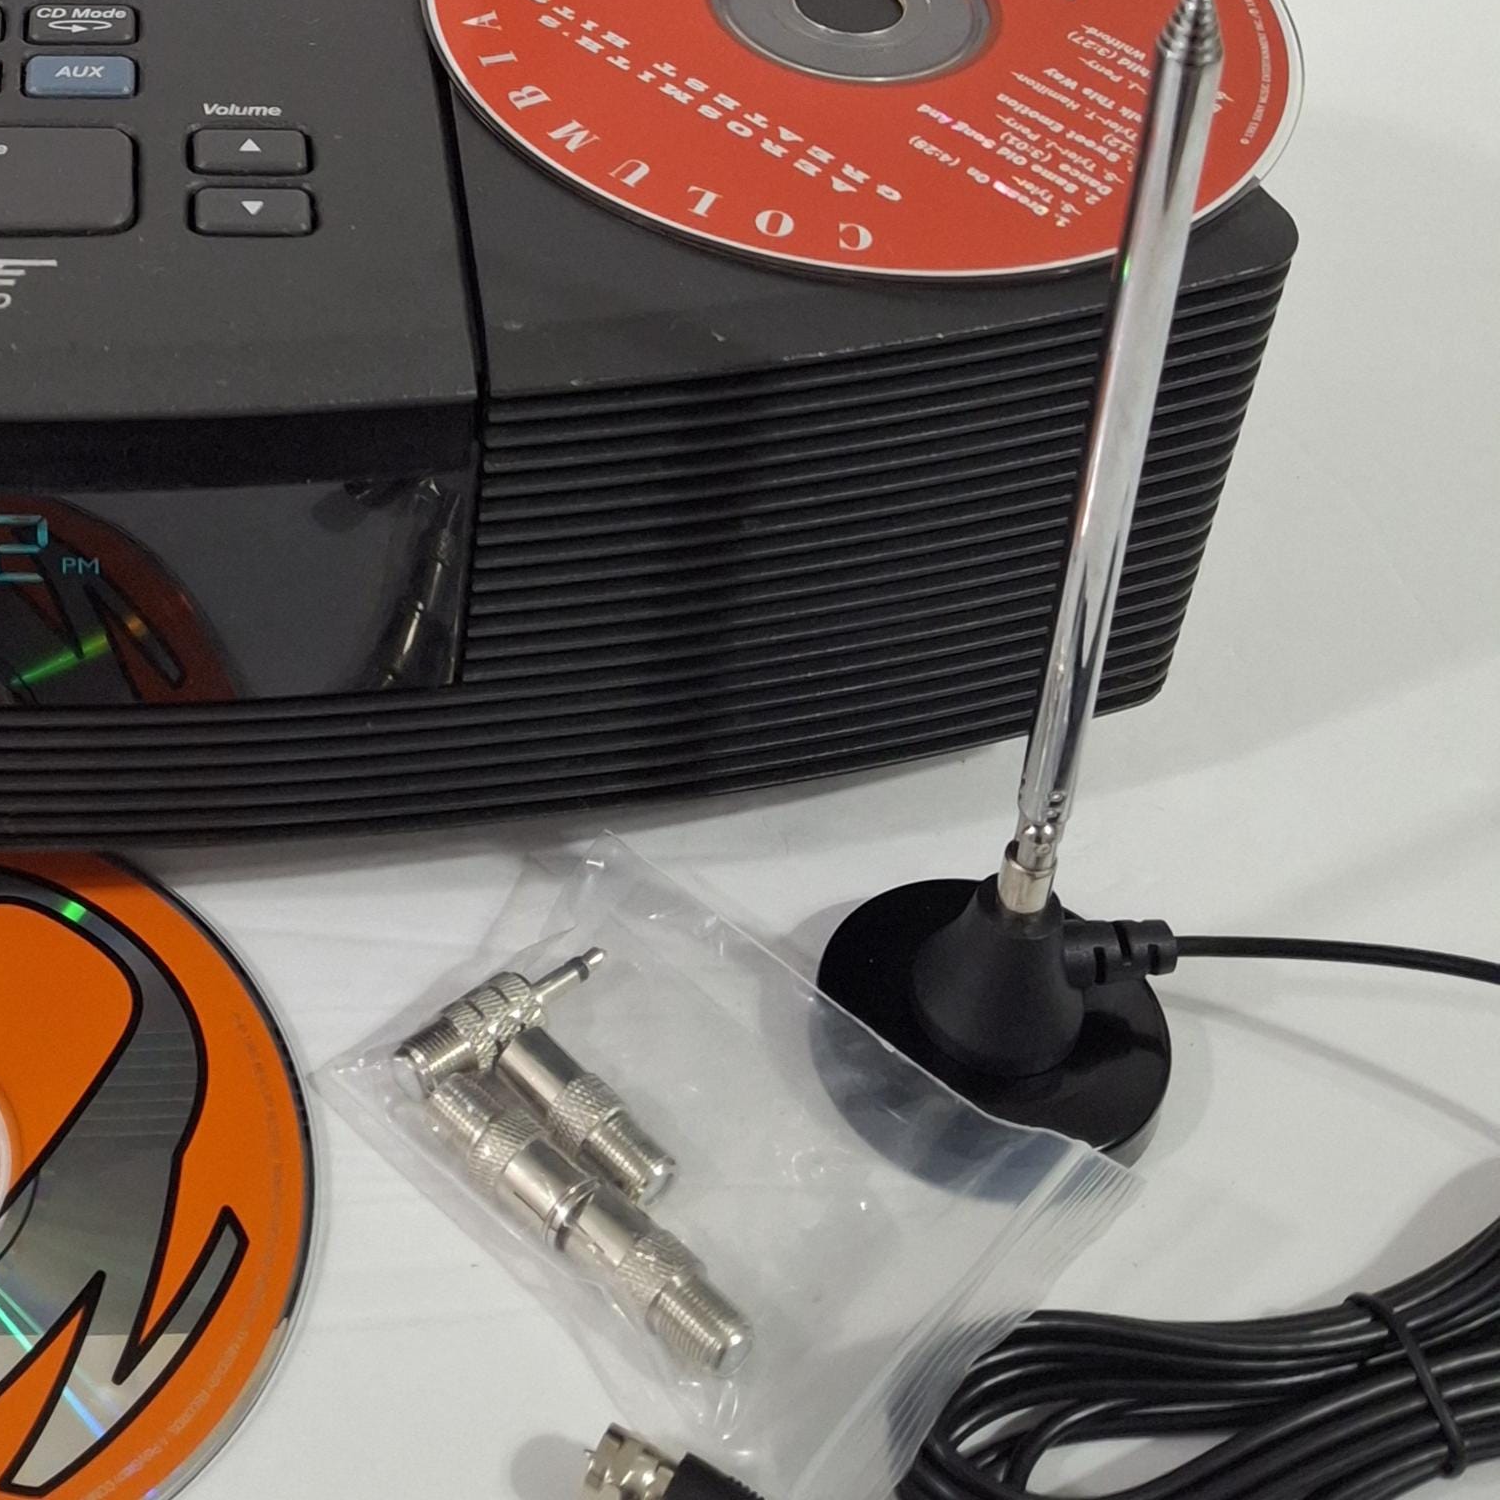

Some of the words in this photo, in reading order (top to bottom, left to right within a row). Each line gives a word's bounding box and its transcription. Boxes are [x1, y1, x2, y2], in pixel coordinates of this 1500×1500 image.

[36, 8, 69, 19] CD
[71, 8, 126, 19] Mode
[55, 65, 104, 78] AUX
[1116, 57, 1150, 77] hild
[1043, 68, 1077, 90] Way
[538, 14, 856, 192] AEROSMITH'S
[1082, 87, 1115, 109] This
[203, 103, 282, 117] Volume
[916, 103, 952, 123] And
[996, 93, 1064, 132] Emotion
[461, 8, 875, 250] COLUMBIA
[652, 62, 901, 201] GREATEST
[951, 120, 996, 148] Song
[996, 146, 1027, 165] Old
[1065, 130, 1120, 162] Sweet
[966, 166, 990, 183] On
[1030, 163, 1078, 193] Same
[1058, 163, 1112, 195] Dance
[993, 180, 1048, 215] Dream
[62, 558, 100, 574] PM
